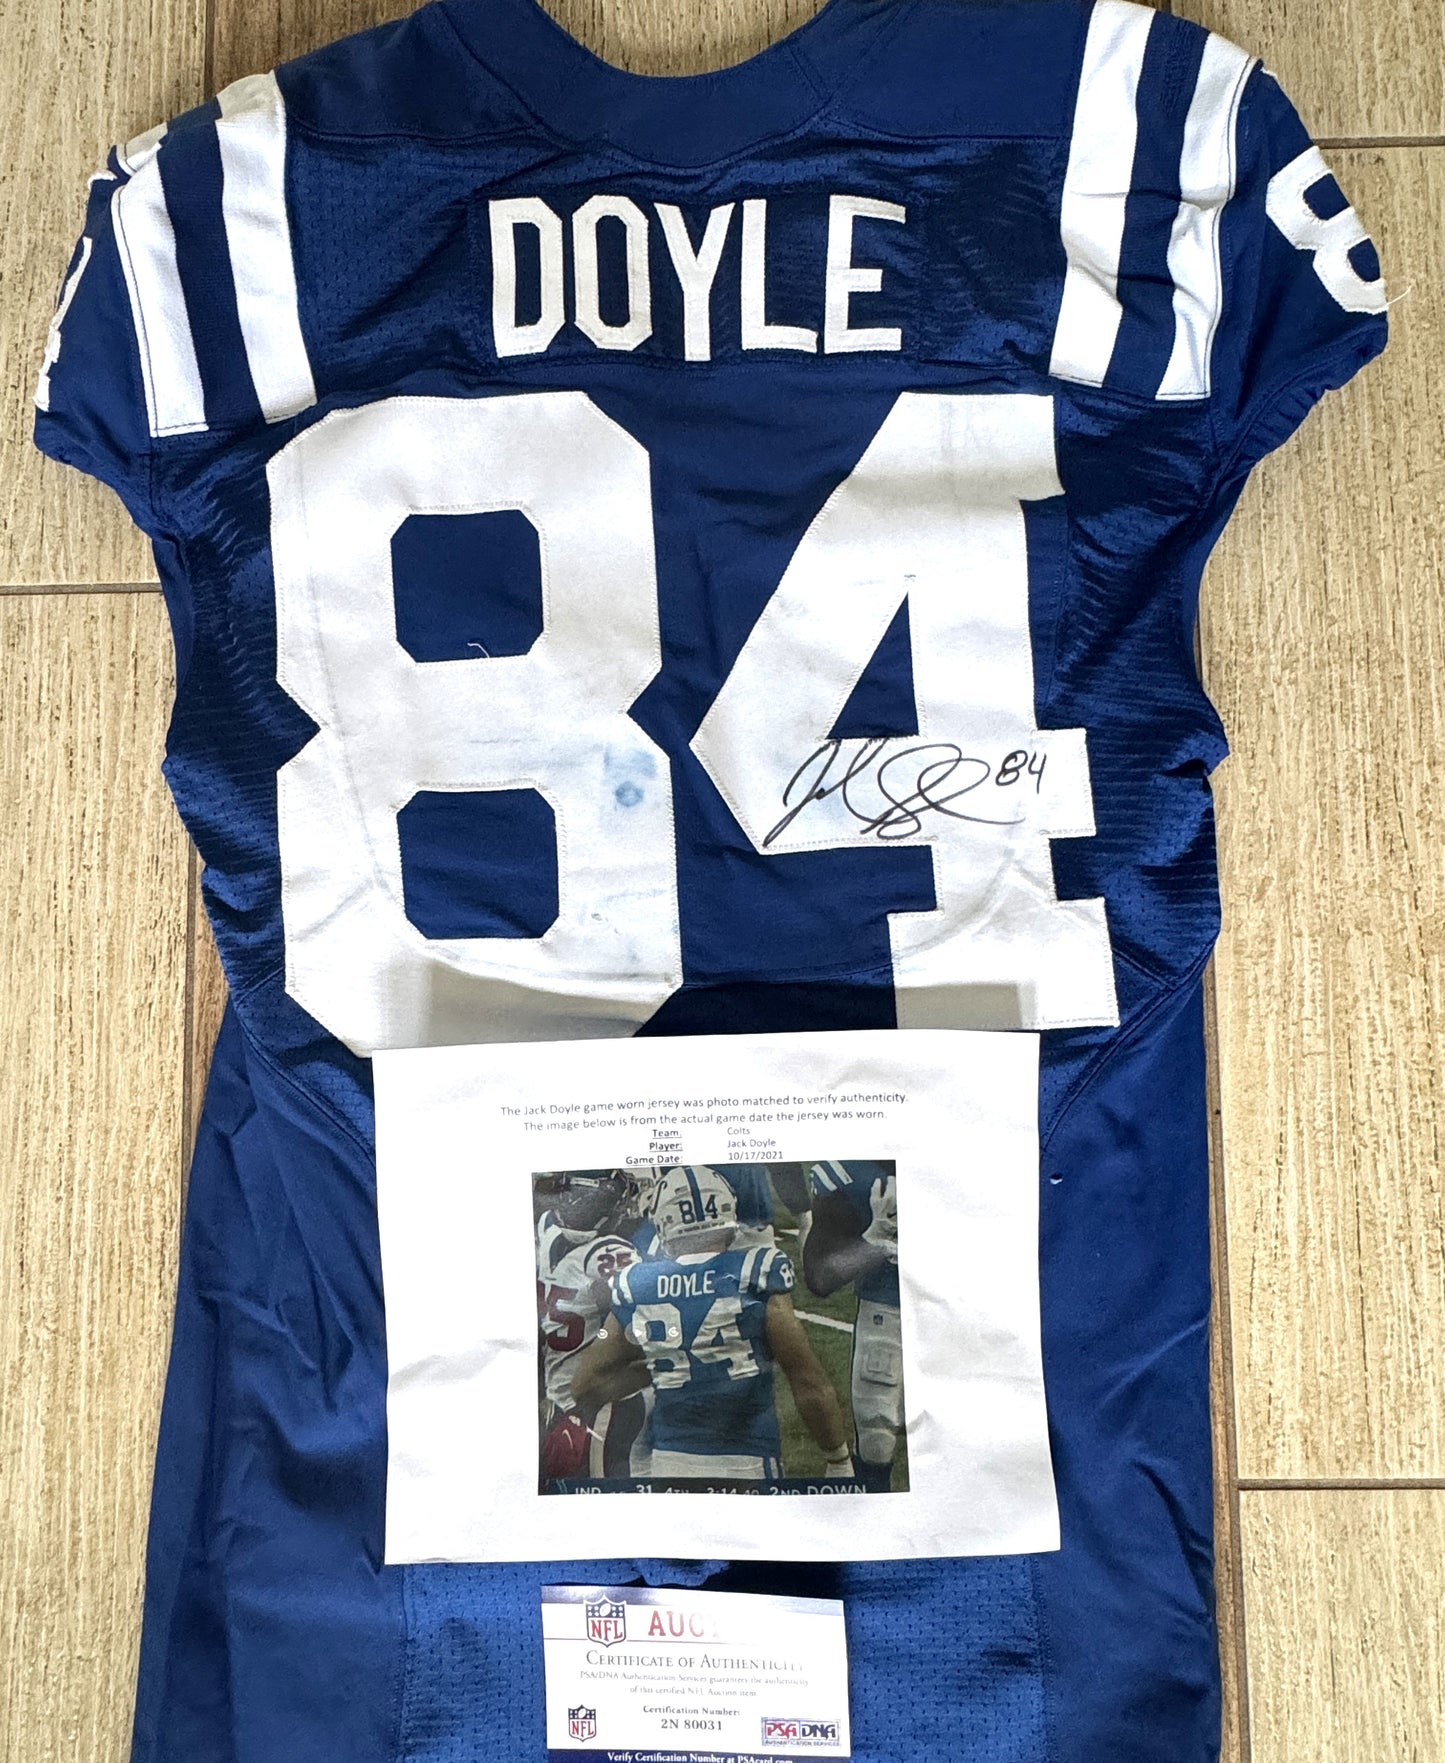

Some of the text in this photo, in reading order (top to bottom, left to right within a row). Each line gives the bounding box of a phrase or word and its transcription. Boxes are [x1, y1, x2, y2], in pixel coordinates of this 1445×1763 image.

[488, 195, 906, 362] DOYLE
[266, 391, 1121, 1059] 84
[995, 750, 1047, 795] 84
[500, 1092, 909, 1116] The Jack Doyle game worn jersey was photo matched to verify authenticity.
[524, 1122, 543, 1131] The
[546, 1121, 580, 1132] image
[583, 1118, 616, 1129] below
[619, 1117, 628, 1127] is
[630, 1116, 657, 1126] from
[660, 1114, 678, 1125] the
[681, 1113, 713, 1124] actual
[716, 1114, 746, 1125] game
[749, 1112, 774, 1122] date
[776, 1111, 795, 1121] the
[797, 1110, 829, 1123] jersey
[832, 1109, 853, 1119] was
[727, 1126, 751, 1136] Colts
[649, 1138, 776, 1152] Player: Jack Doyle
[625, 1151, 783, 1165] Game Date: 10/17/2021
[657, 1269, 716, 1299] DOYLE
[632, 1296, 760, 1391] 84
[807, 1484, 867, 1495] DOWN
[590, 1619, 623, 1642] NFL
[580, 1670, 619, 1680] PSA/DNA
[630, 1685, 639, 1693] of
[643, 1705, 741, 1717] Certification Number:
[571, 1718, 722, 1738] NFL 2N 80031
[766, 1722, 836, 1740] PSA DNA
[607, 1752, 633, 1762] Verify
[635, 1752, 687, 1762] Certification
[689, 1753, 725, 1763] Number
[726, 1755, 736, 1763] at
